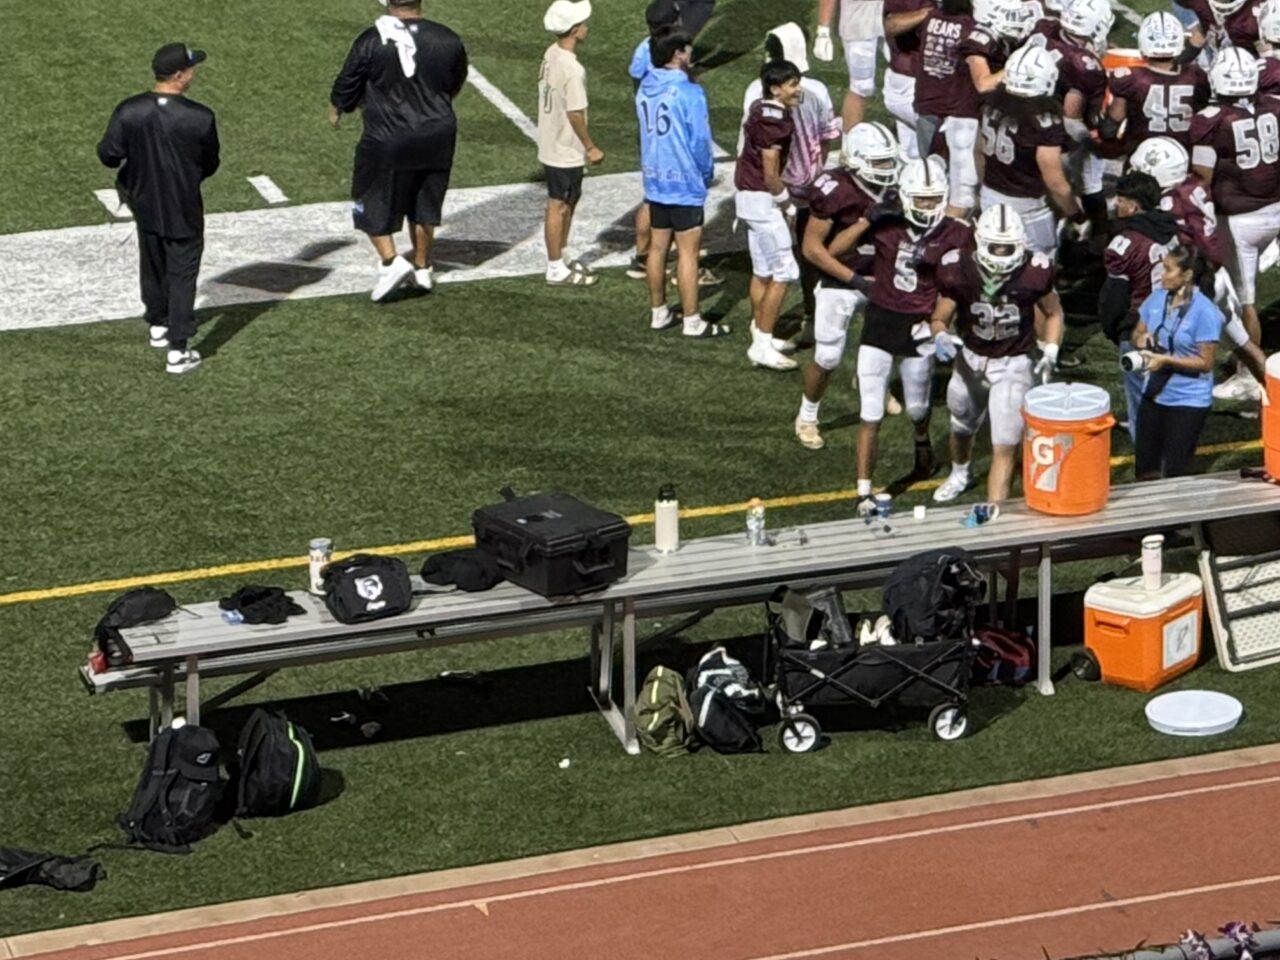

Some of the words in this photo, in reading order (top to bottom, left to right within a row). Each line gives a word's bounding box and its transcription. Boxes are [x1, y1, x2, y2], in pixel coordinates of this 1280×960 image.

[926, 17, 962, 40] BEARS
[640, 99, 672, 137] 16
[1142, 84, 1196, 133] 45
[1231, 112, 1280, 171] 58
[893, 248, 918, 293] 5
[969, 302, 1021, 342] 32
[1031, 435, 1055, 466] G
